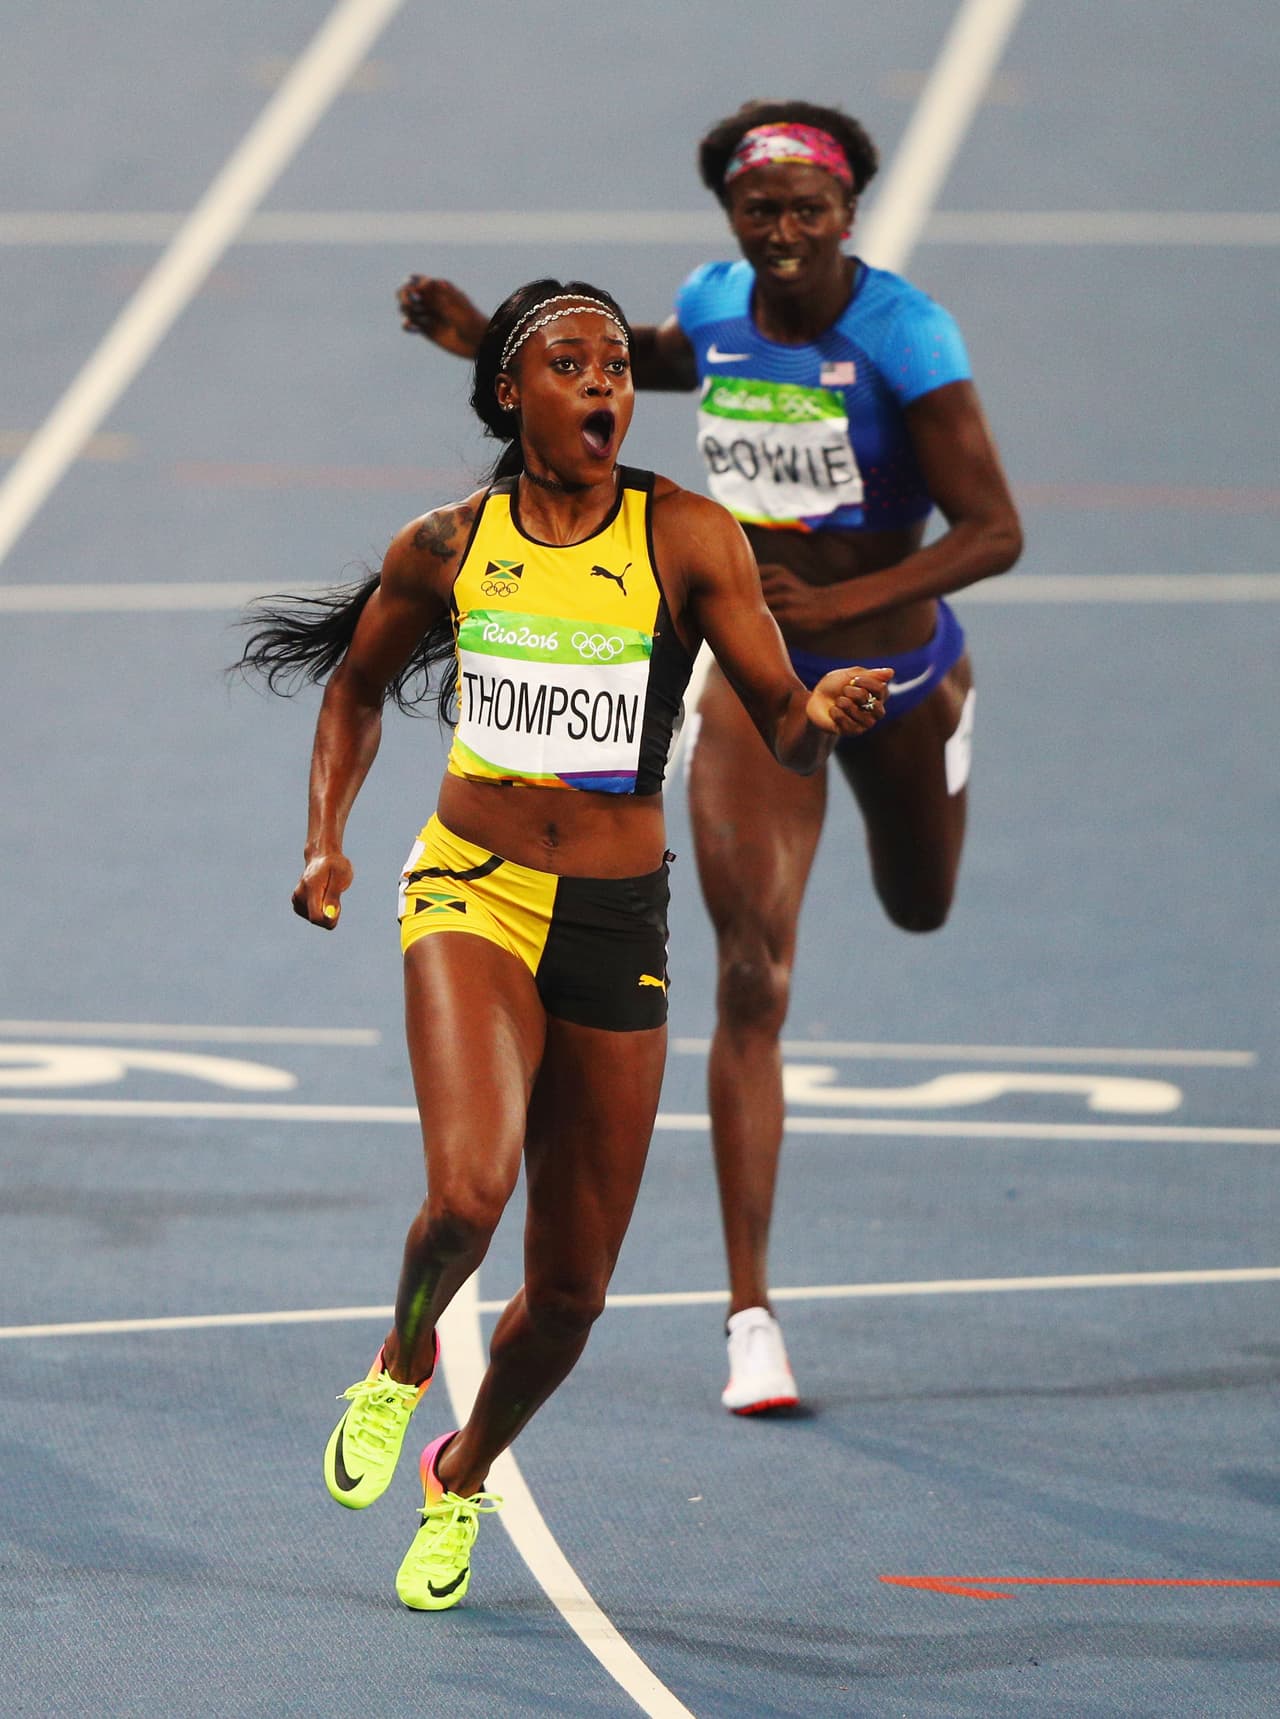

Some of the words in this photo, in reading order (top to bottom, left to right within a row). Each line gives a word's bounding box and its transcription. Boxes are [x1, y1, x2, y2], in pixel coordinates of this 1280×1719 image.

[703, 436, 853, 488] BOWIE
[482, 622, 559, 651] Rio2016
[463, 672, 639, 744] THOMPSON
